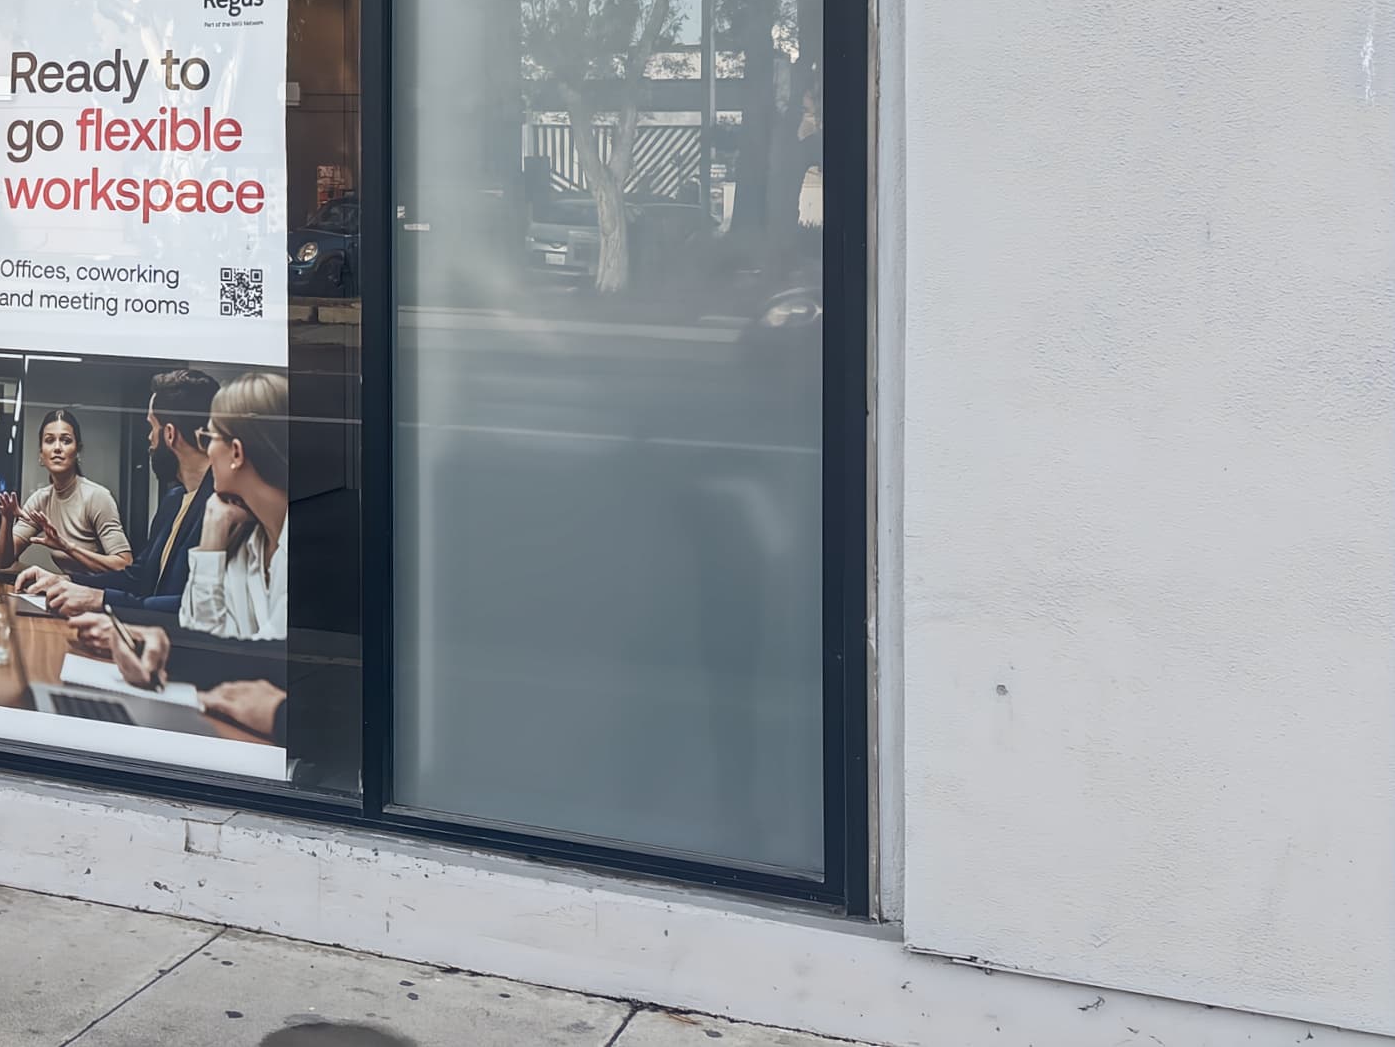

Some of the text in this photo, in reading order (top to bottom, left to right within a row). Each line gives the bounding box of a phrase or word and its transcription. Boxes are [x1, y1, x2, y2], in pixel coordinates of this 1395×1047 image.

[10, 48, 211, 103] Ready to
[6, 107, 243, 163] go flexible
[4, 167, 265, 224] workspace
[0, 259, 180, 289] Offices, coworking
[39, 293, 118, 316] meeting
[124, 299, 190, 315] rooms
